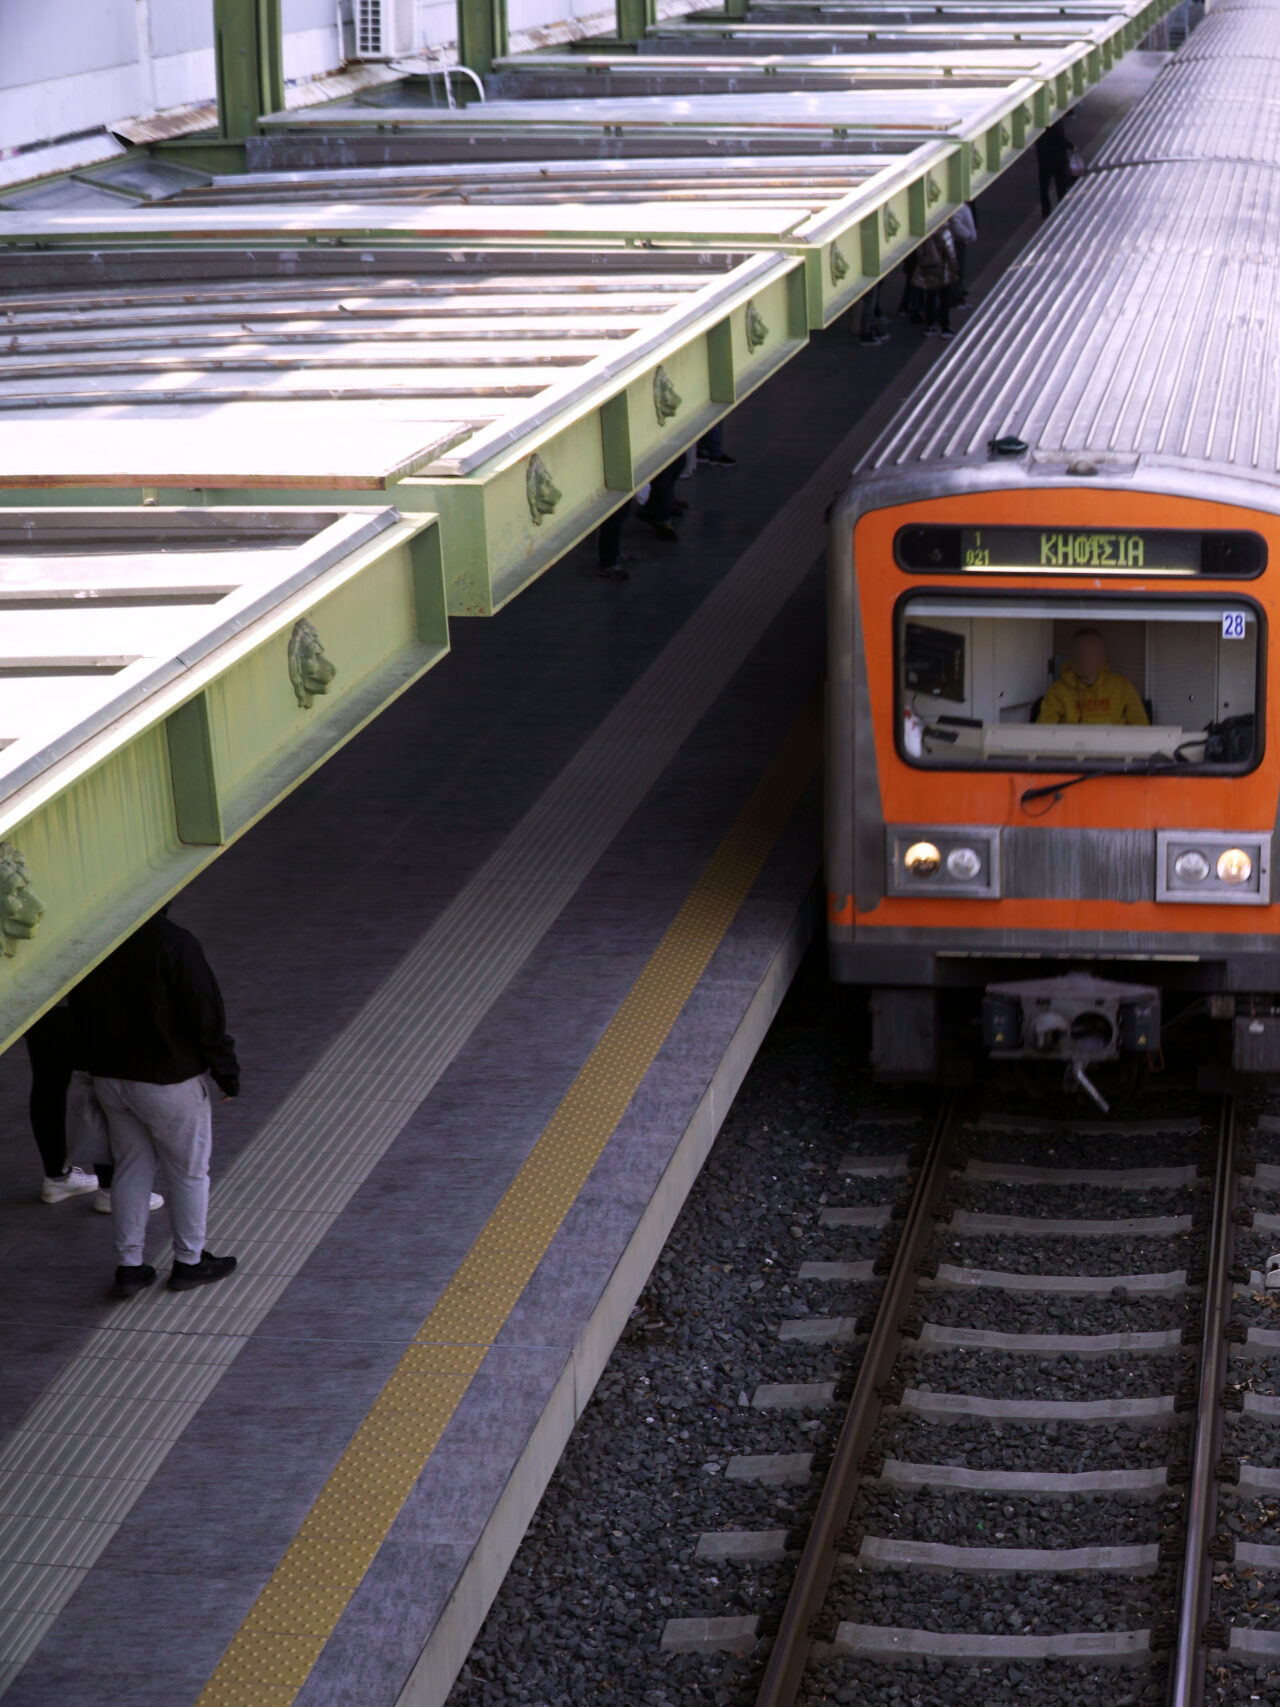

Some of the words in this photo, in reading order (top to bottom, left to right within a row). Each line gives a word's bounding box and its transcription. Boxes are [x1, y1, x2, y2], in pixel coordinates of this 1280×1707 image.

[974, 530, 981, 547] 1
[966, 548, 990, 567] 021
[1224, 614, 1243, 635] 28
